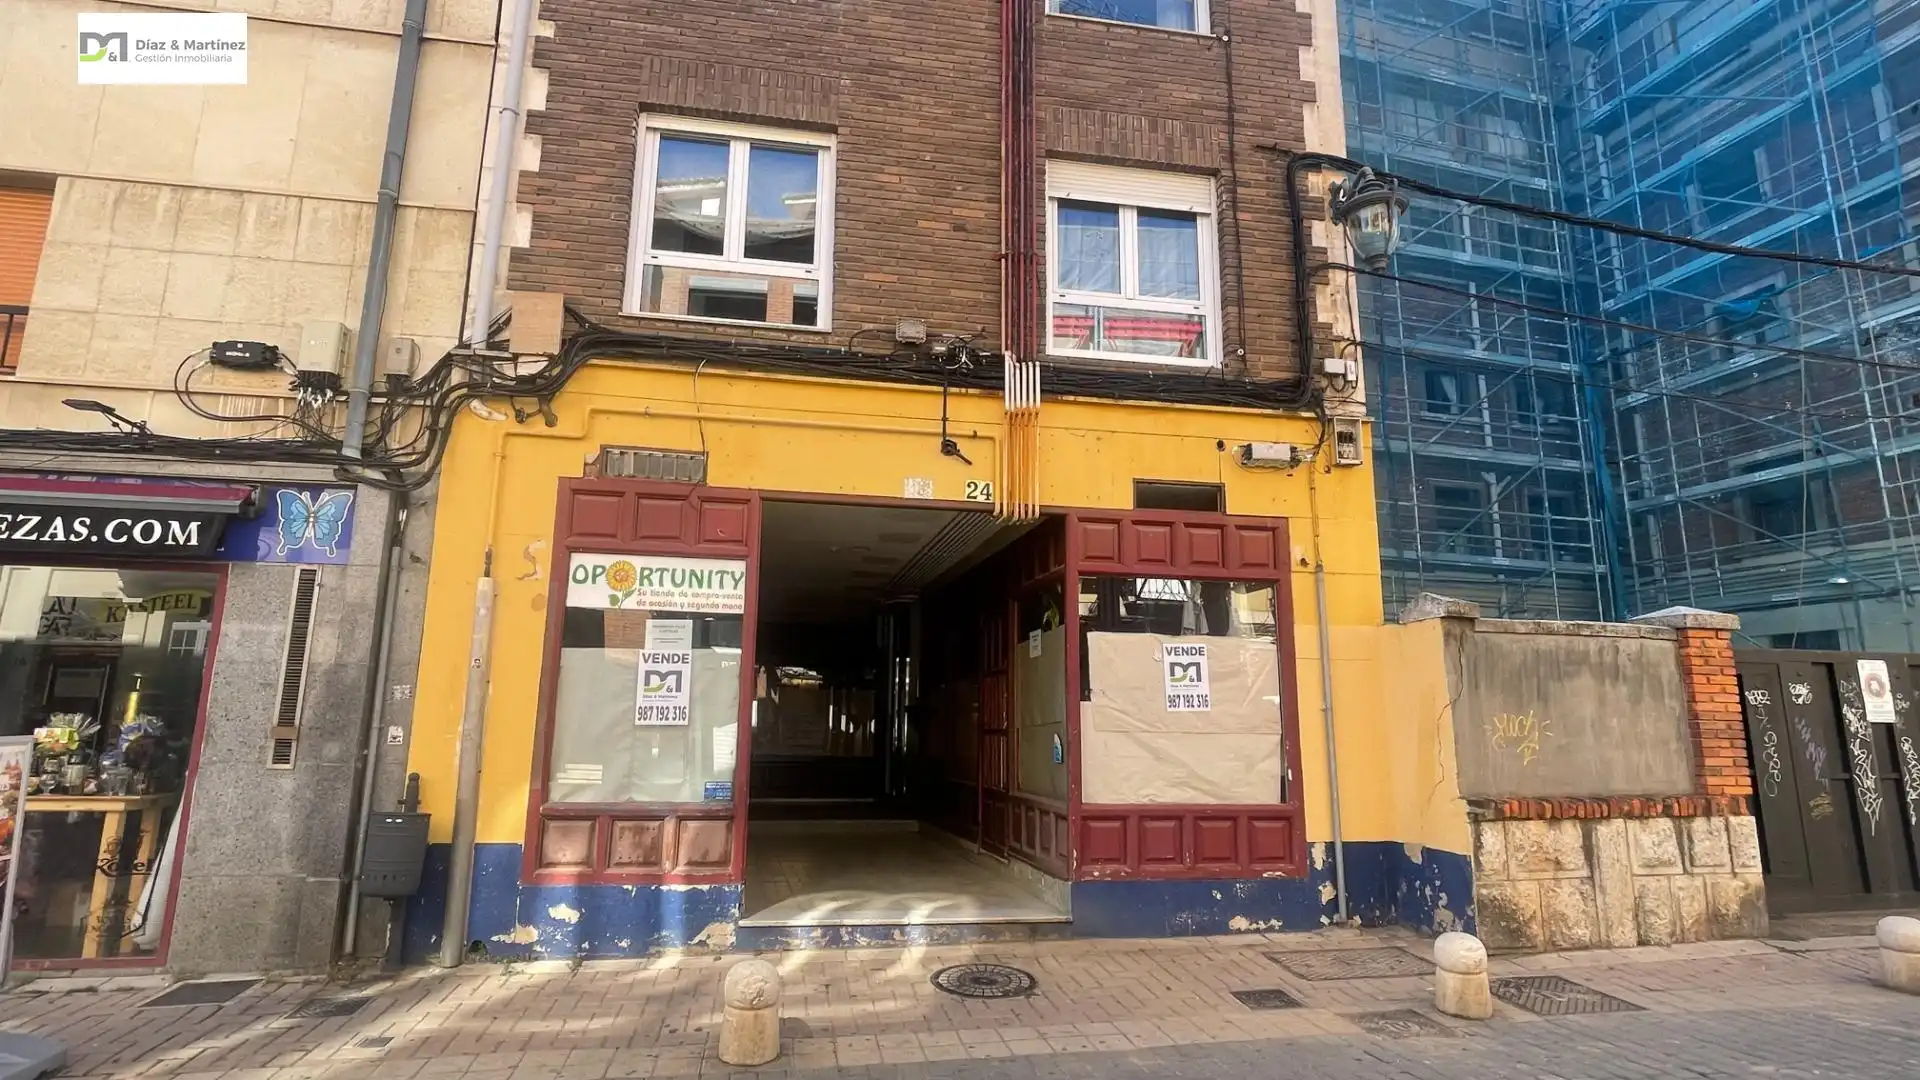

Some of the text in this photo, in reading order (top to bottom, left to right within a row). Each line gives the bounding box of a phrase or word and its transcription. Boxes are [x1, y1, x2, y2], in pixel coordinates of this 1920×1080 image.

[966, 481, 992, 500] 24
[637, 588, 647, 596] Su
[650, 588, 675, 597] tienda
[678, 589, 688, 598] de
[636, 599, 646, 607] de
[687, 601, 719, 610] segunda
[1165, 646, 1205, 656] VENDE
[642, 652, 690, 664] VENDE
[1168, 694, 1209, 708] 987 192 316
[637, 706, 687, 721] 987 192 316
